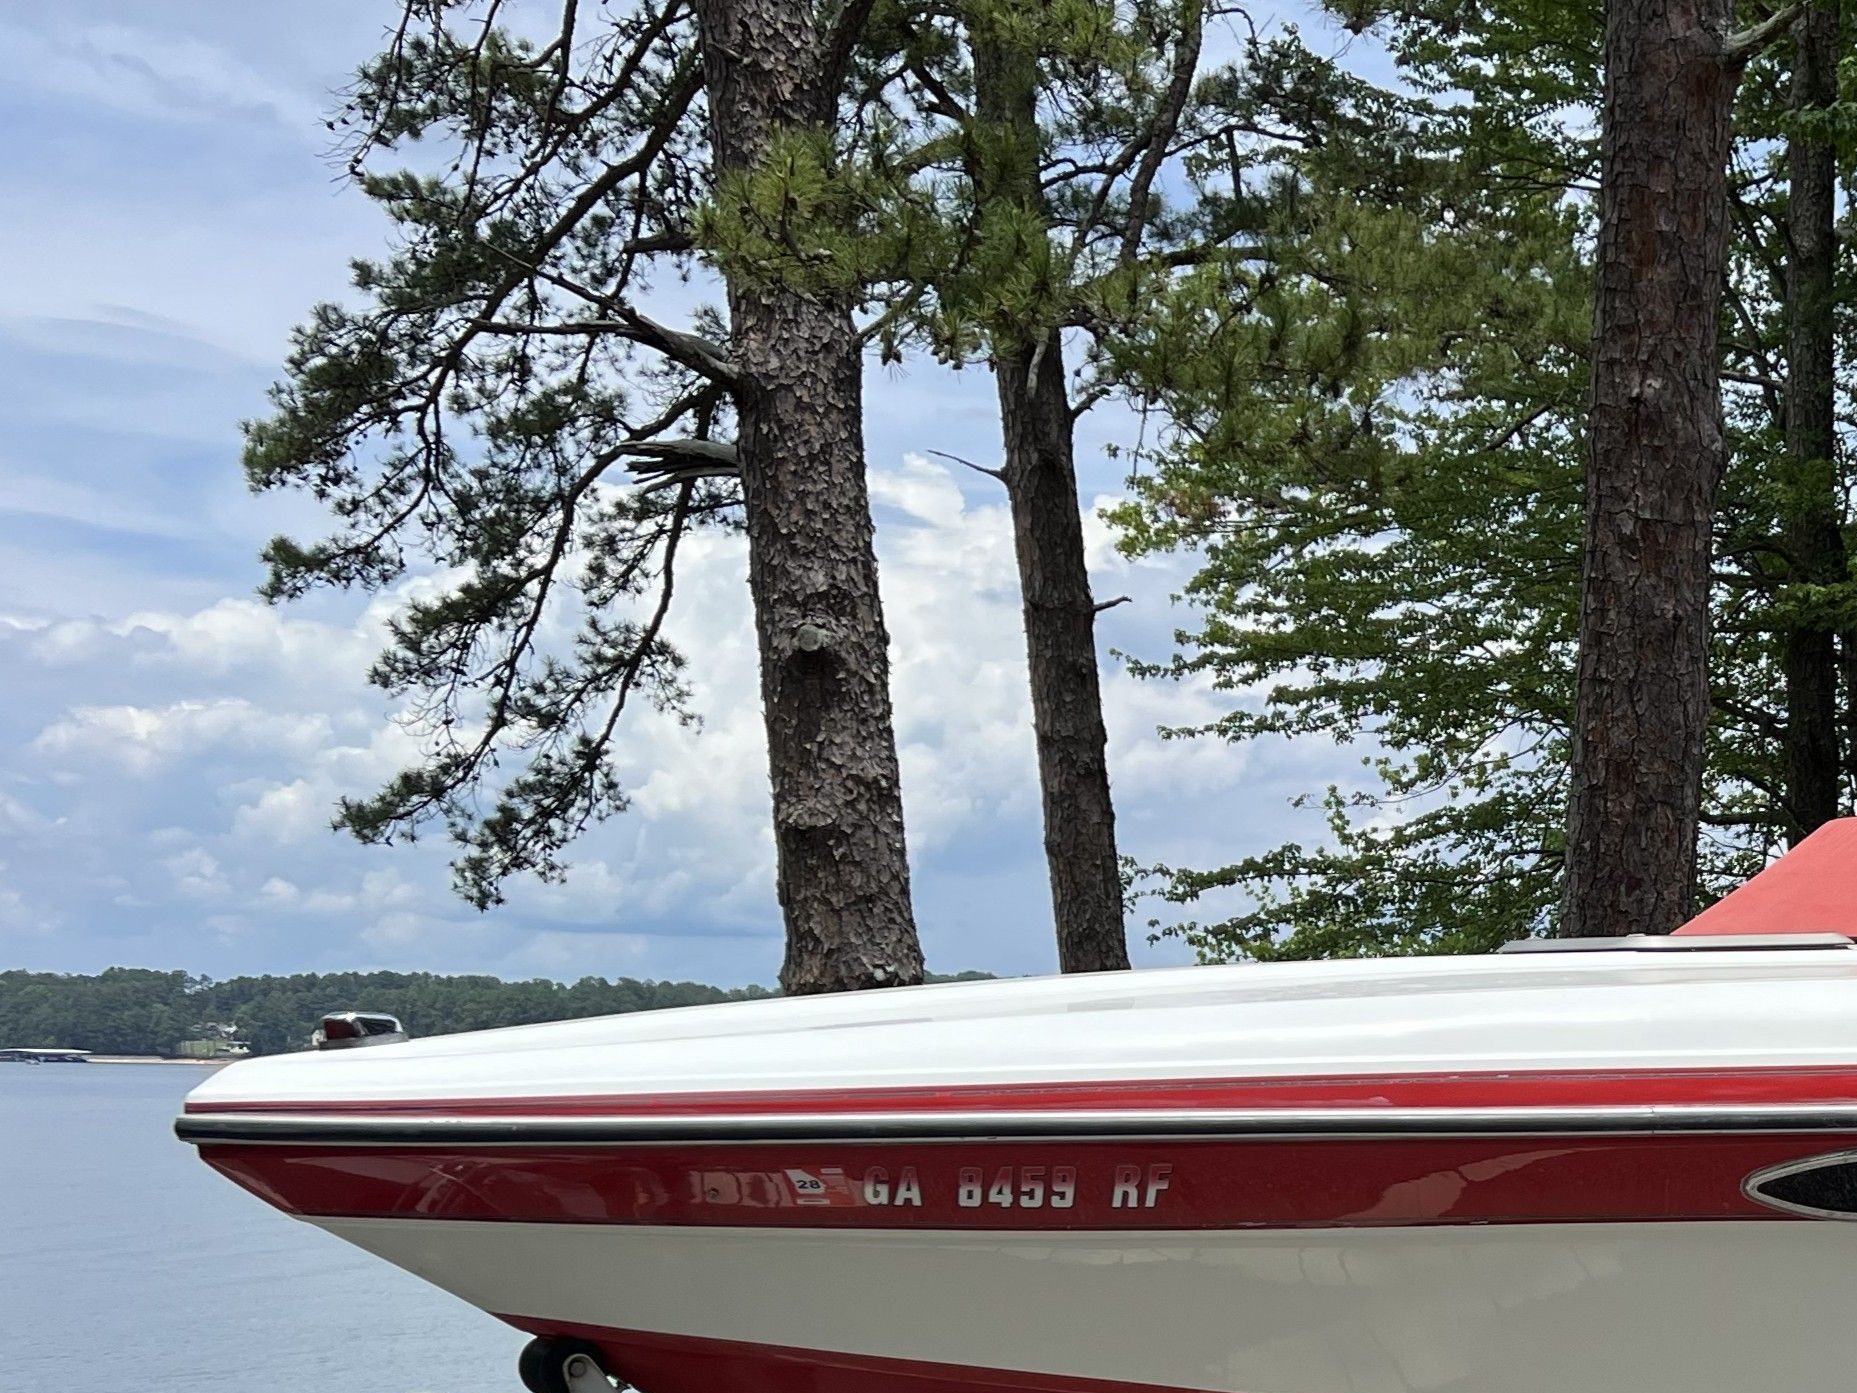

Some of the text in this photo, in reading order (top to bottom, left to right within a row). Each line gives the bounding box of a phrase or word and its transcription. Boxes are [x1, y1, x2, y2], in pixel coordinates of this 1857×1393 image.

[796, 1179, 821, 1190] 28
[863, 1165, 922, 1206] GA
[957, 1165, 1077, 1208] 8459
[1111, 1163, 1173, 1208] RF
